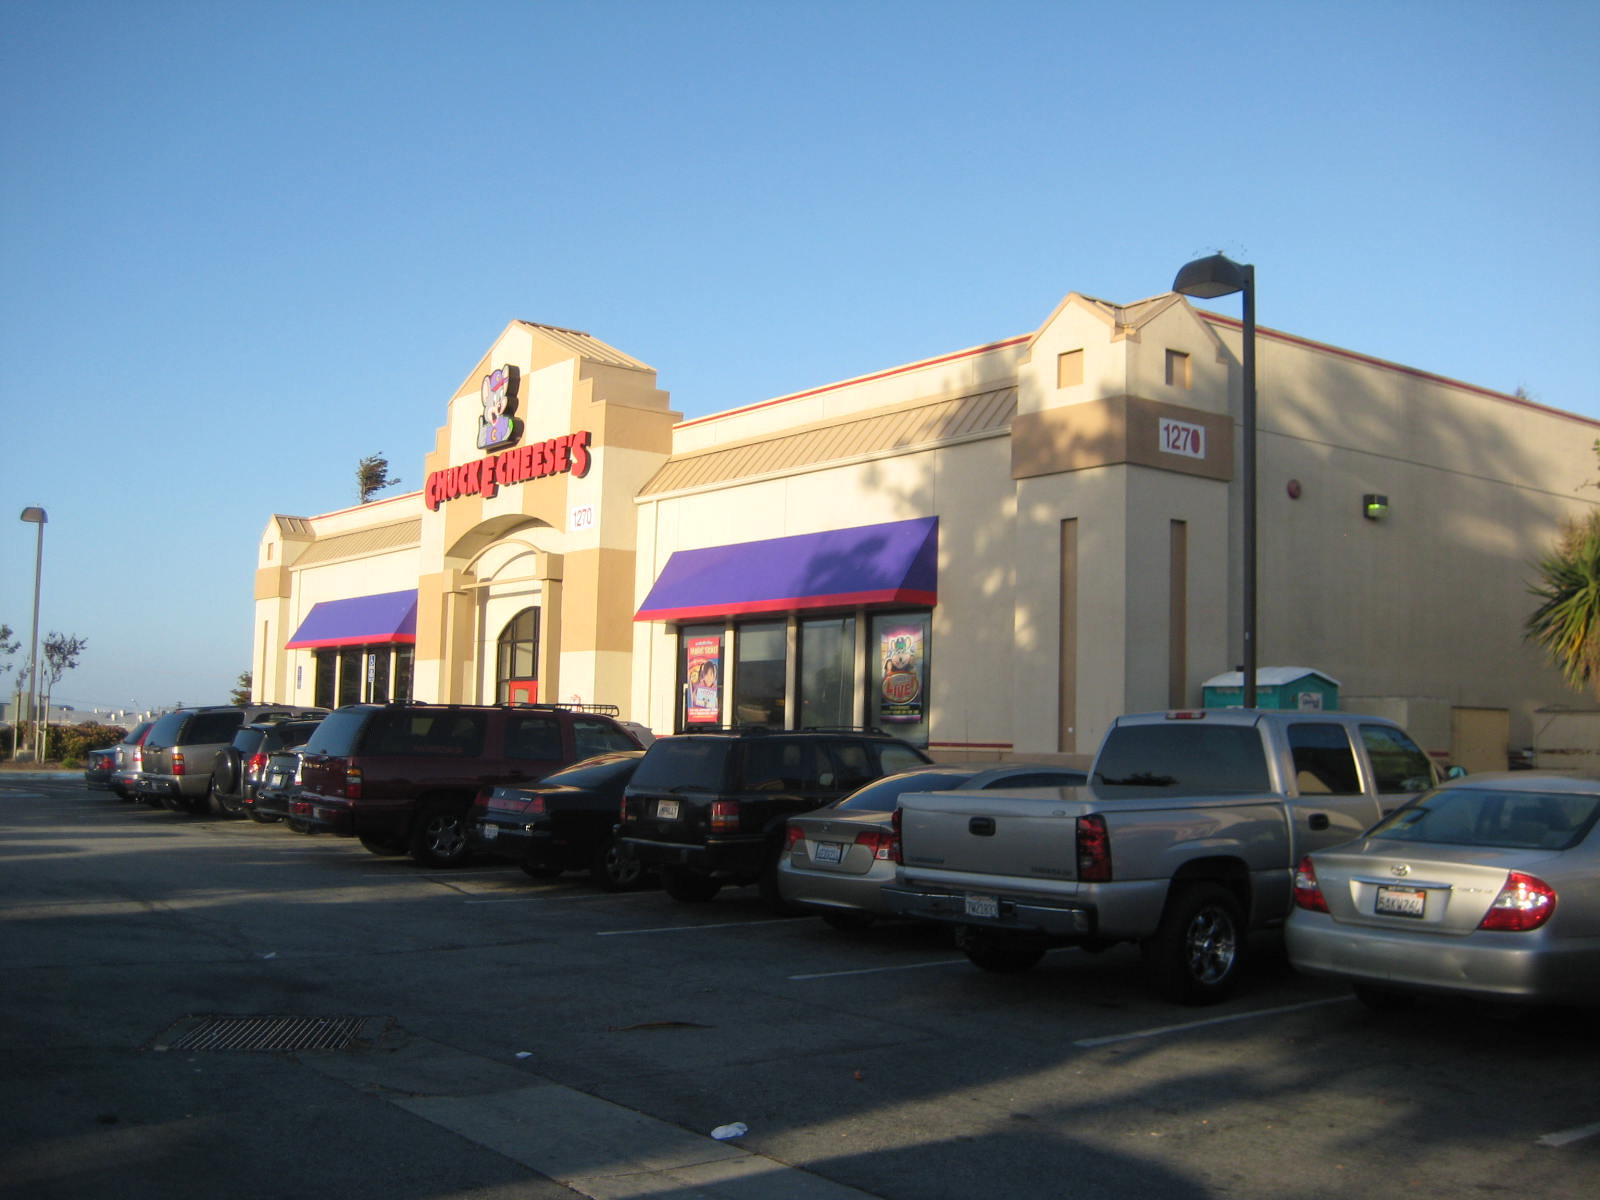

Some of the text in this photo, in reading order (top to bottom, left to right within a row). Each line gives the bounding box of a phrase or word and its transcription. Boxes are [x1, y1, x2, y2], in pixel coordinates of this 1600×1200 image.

[1163, 422, 1201, 454] 1270
[425, 431, 589, 511] CHUCK E CHEESE'S
[573, 507, 592, 527] 1270
